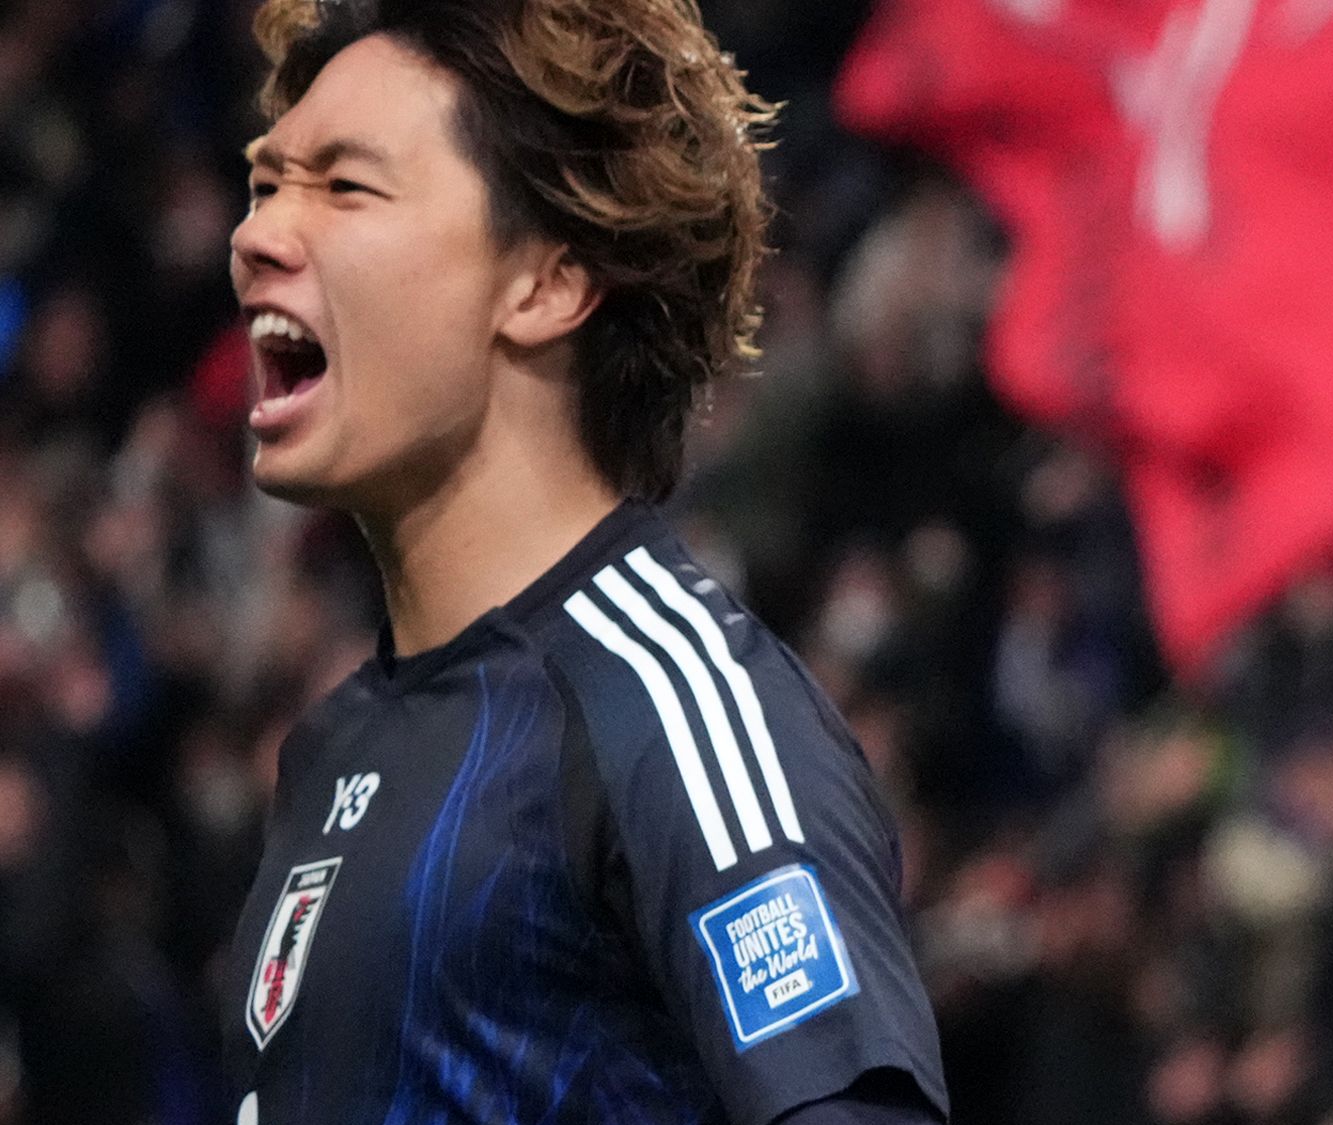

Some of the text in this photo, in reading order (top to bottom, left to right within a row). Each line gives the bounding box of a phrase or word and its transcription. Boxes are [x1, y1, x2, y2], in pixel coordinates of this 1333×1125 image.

[726, 893, 799, 943] FOOTBALL
[733, 912, 807, 967] UNITES
[738, 934, 819, 993] the World
[772, 978, 802, 999] FIFA
